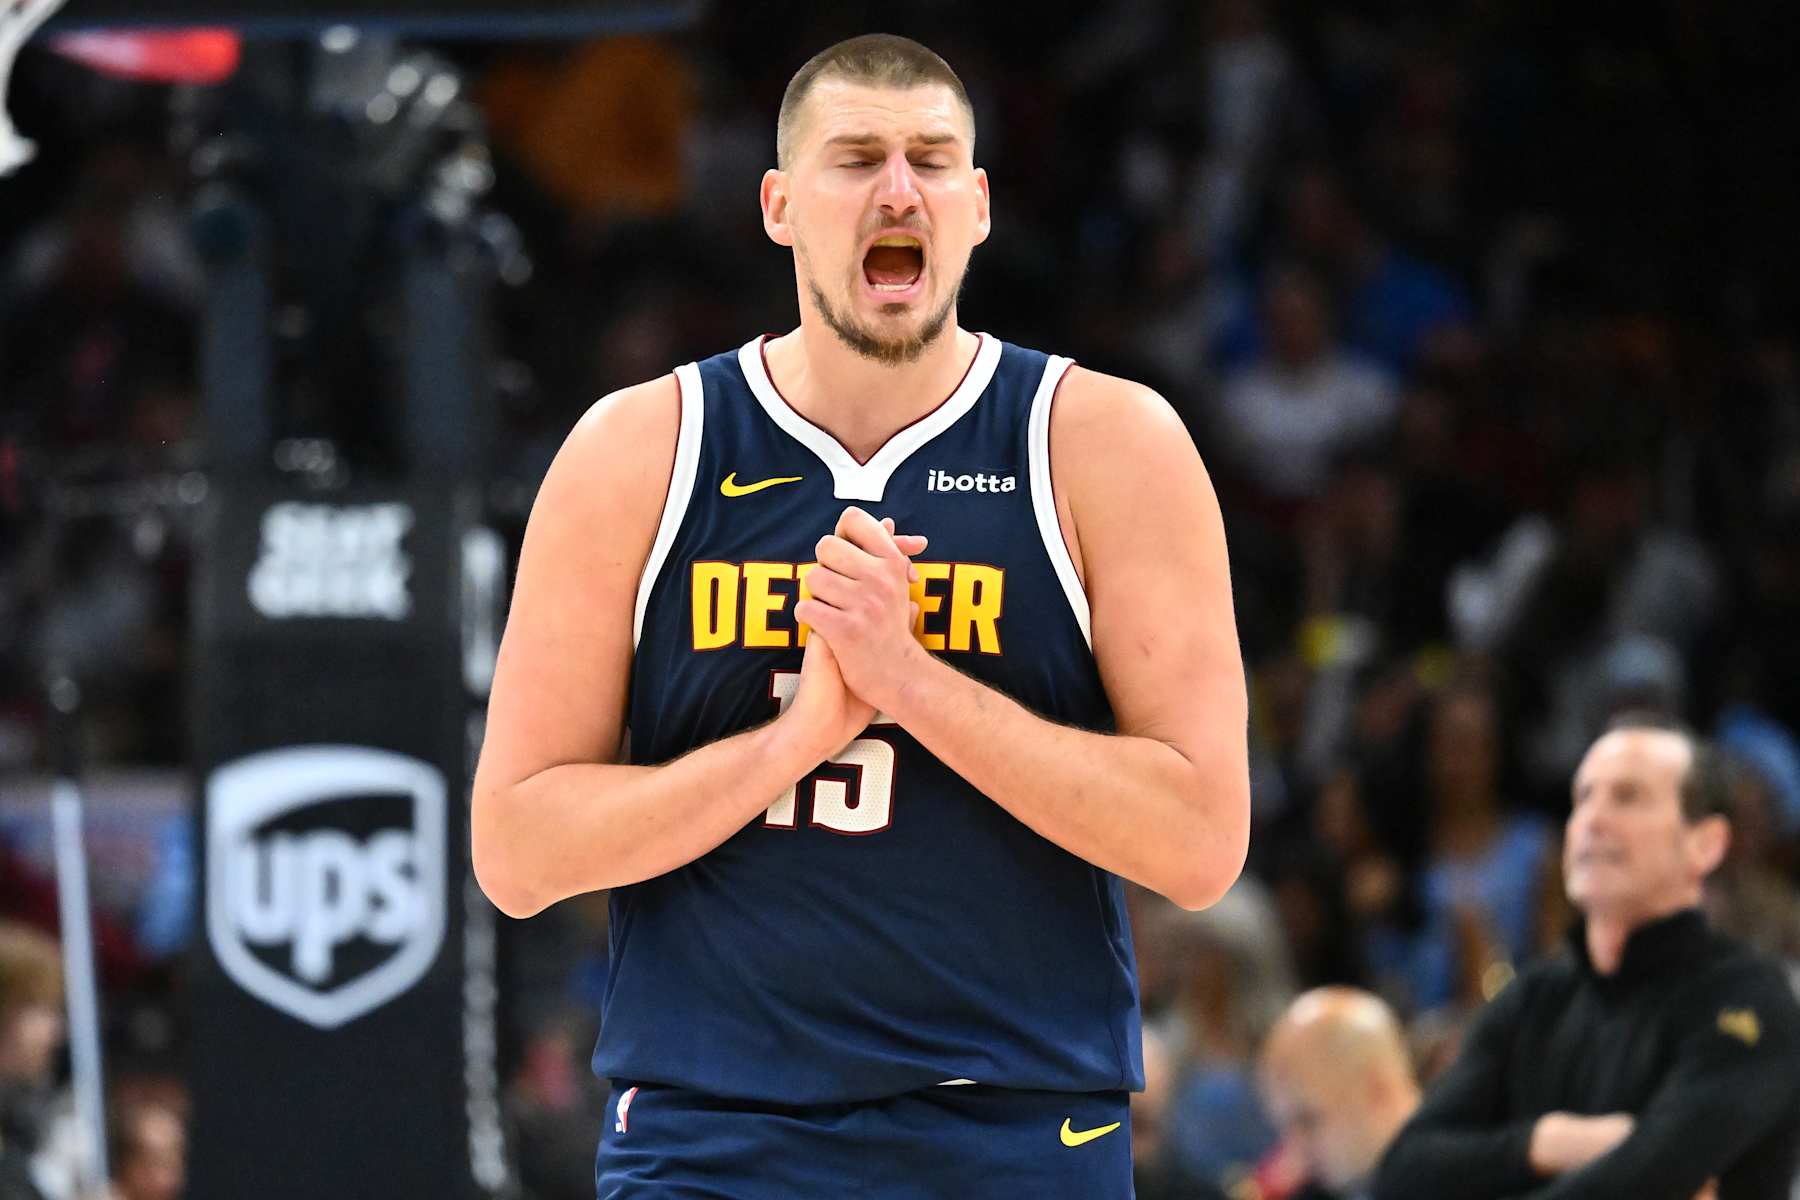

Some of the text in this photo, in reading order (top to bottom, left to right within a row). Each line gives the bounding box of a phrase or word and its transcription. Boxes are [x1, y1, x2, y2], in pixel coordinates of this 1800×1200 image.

[927, 468, 1017, 494] ibotta
[690, 560, 1005, 656] DEER
[228, 831, 422, 983] ups
